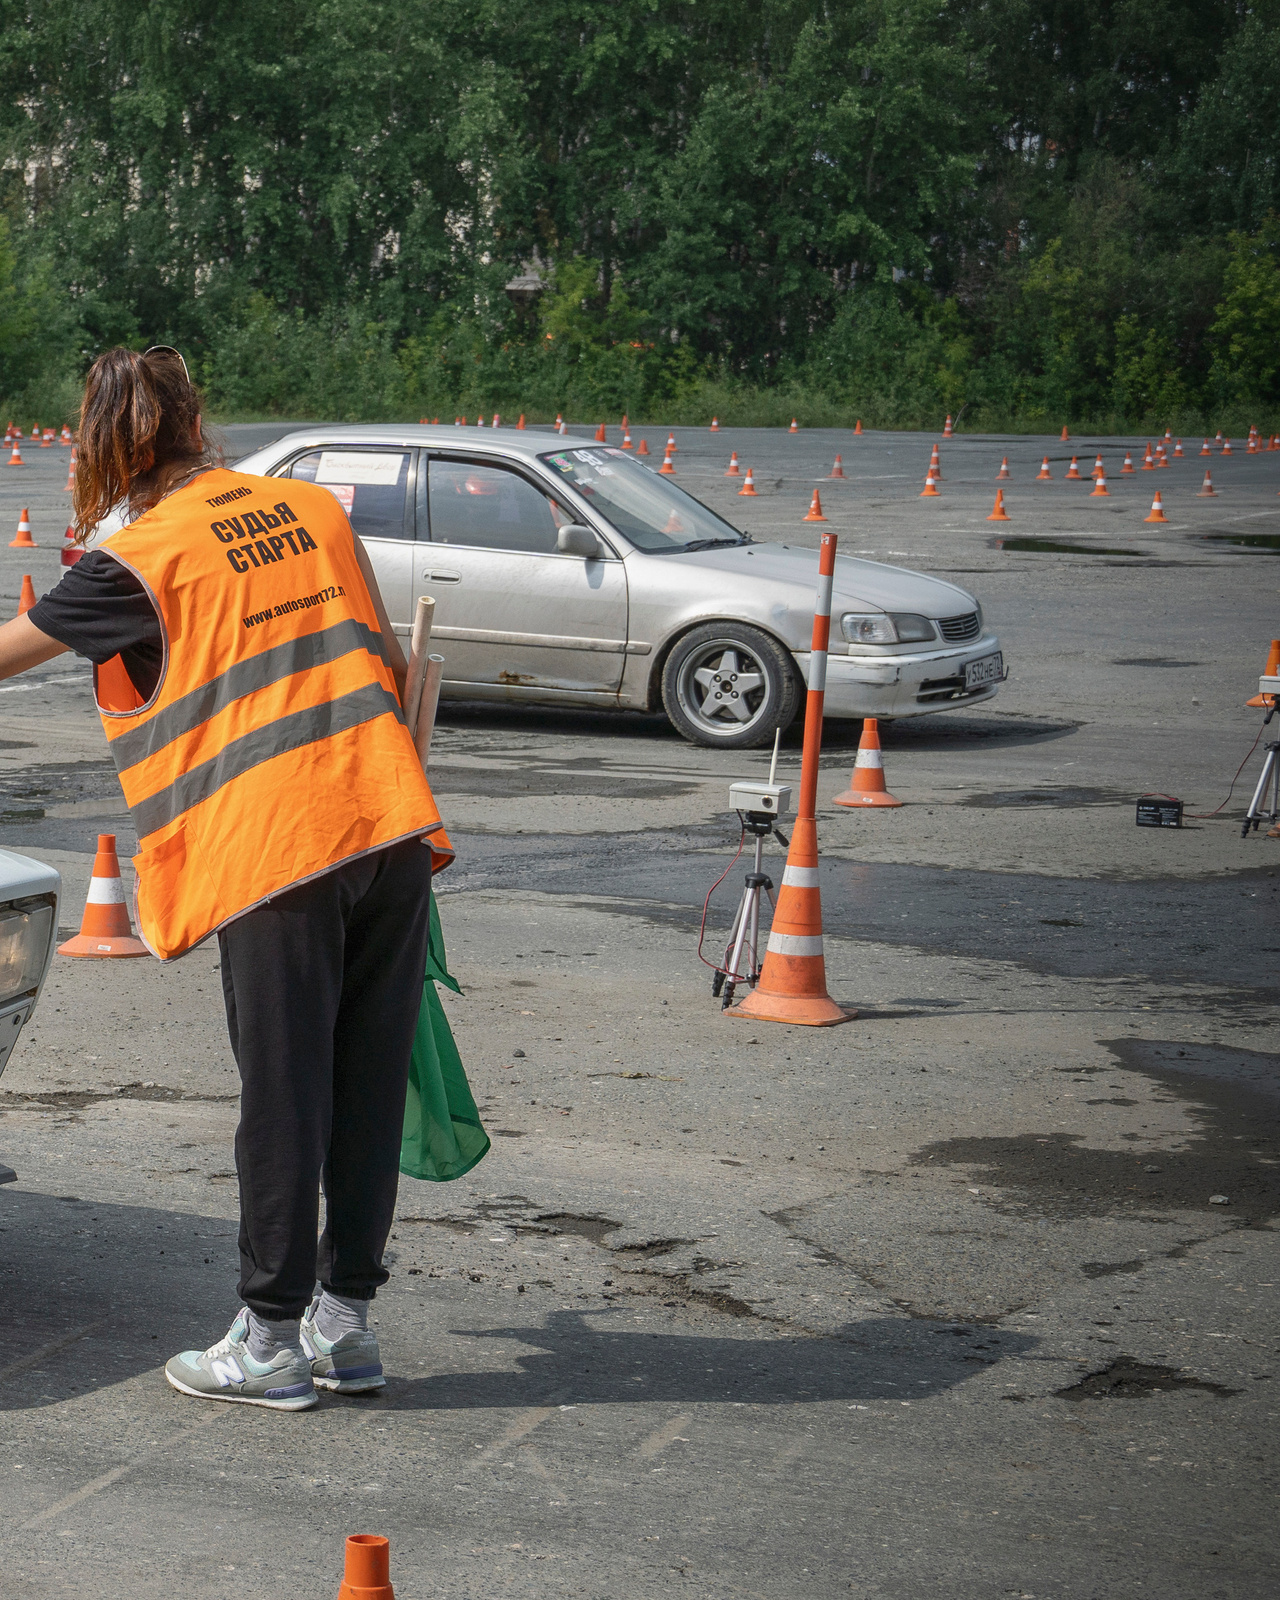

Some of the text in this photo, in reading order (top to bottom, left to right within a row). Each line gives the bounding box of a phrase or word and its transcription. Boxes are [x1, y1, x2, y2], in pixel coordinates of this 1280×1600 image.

[205, 486, 253, 508] ТЮМЕНЬ
[210, 501, 298, 544] СУДЬЯ
[226, 526, 318, 574] СТАРТА
